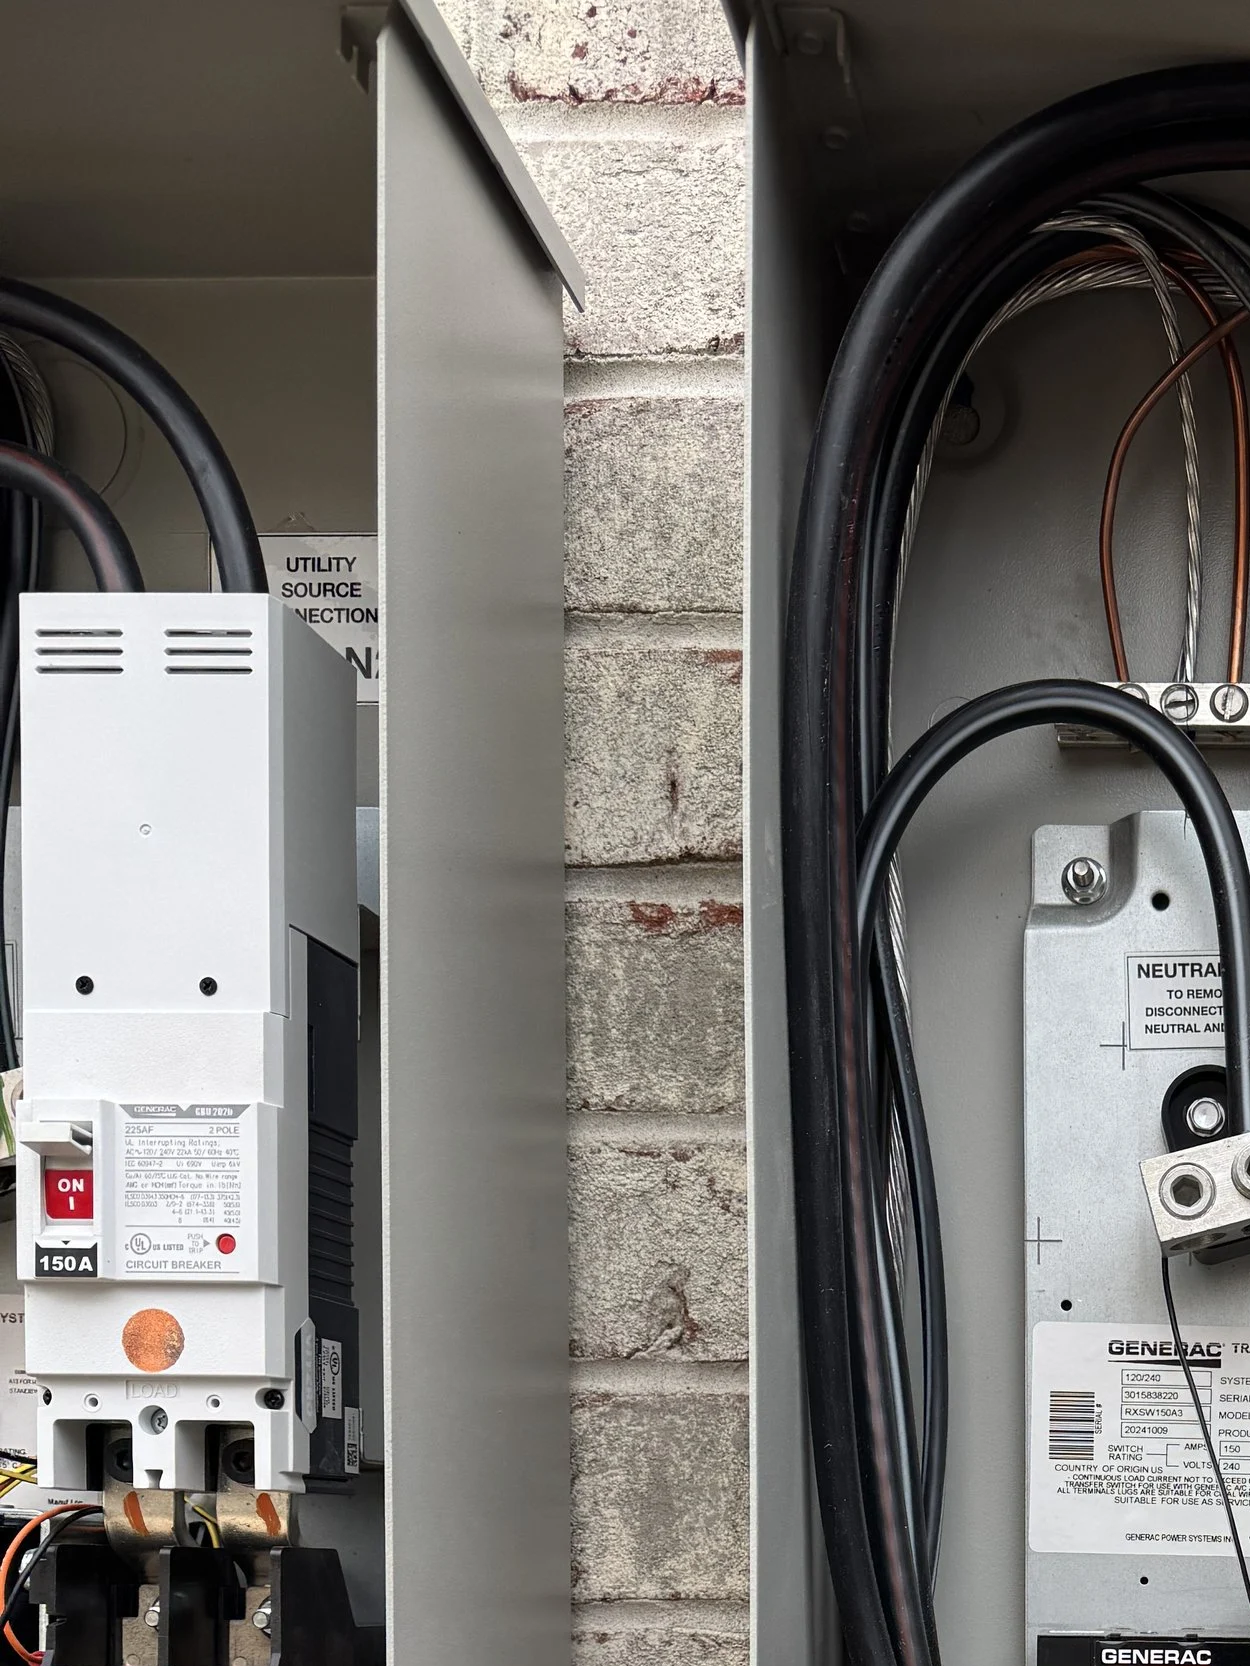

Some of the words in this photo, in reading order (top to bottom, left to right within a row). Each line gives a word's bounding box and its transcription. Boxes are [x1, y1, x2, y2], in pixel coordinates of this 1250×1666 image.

[287, 557, 357, 572] UTILITY
[282, 583, 362, 598] SOURCE
[1138, 961, 1222, 978] NEUTRA
[1167, 990, 1183, 999] TO
[1187, 989, 1223, 998] REMO
[1146, 1006, 1224, 1016] DISCONNECT
[1145, 1024, 1200, 1034] NEUTRAL
[125, 1126, 153, 1134] 225AF
[58, 1179, 84, 1192] ON
[40, 1256, 93, 1271] 150A
[126, 1261, 168, 1269] CIRCUIT
[172, 1261, 221, 1269] BREAKER
[1125, 1374, 1161, 1382] 120/240
[130, 1382, 178, 1398] LOAD
[1125, 1408, 1183, 1416] RXSW150A3
[1125, 1426, 1168, 1434] 20241009
[1162, 1534, 1187, 1542] POWER
[1102, 1649, 1211, 1665] GENERAC
